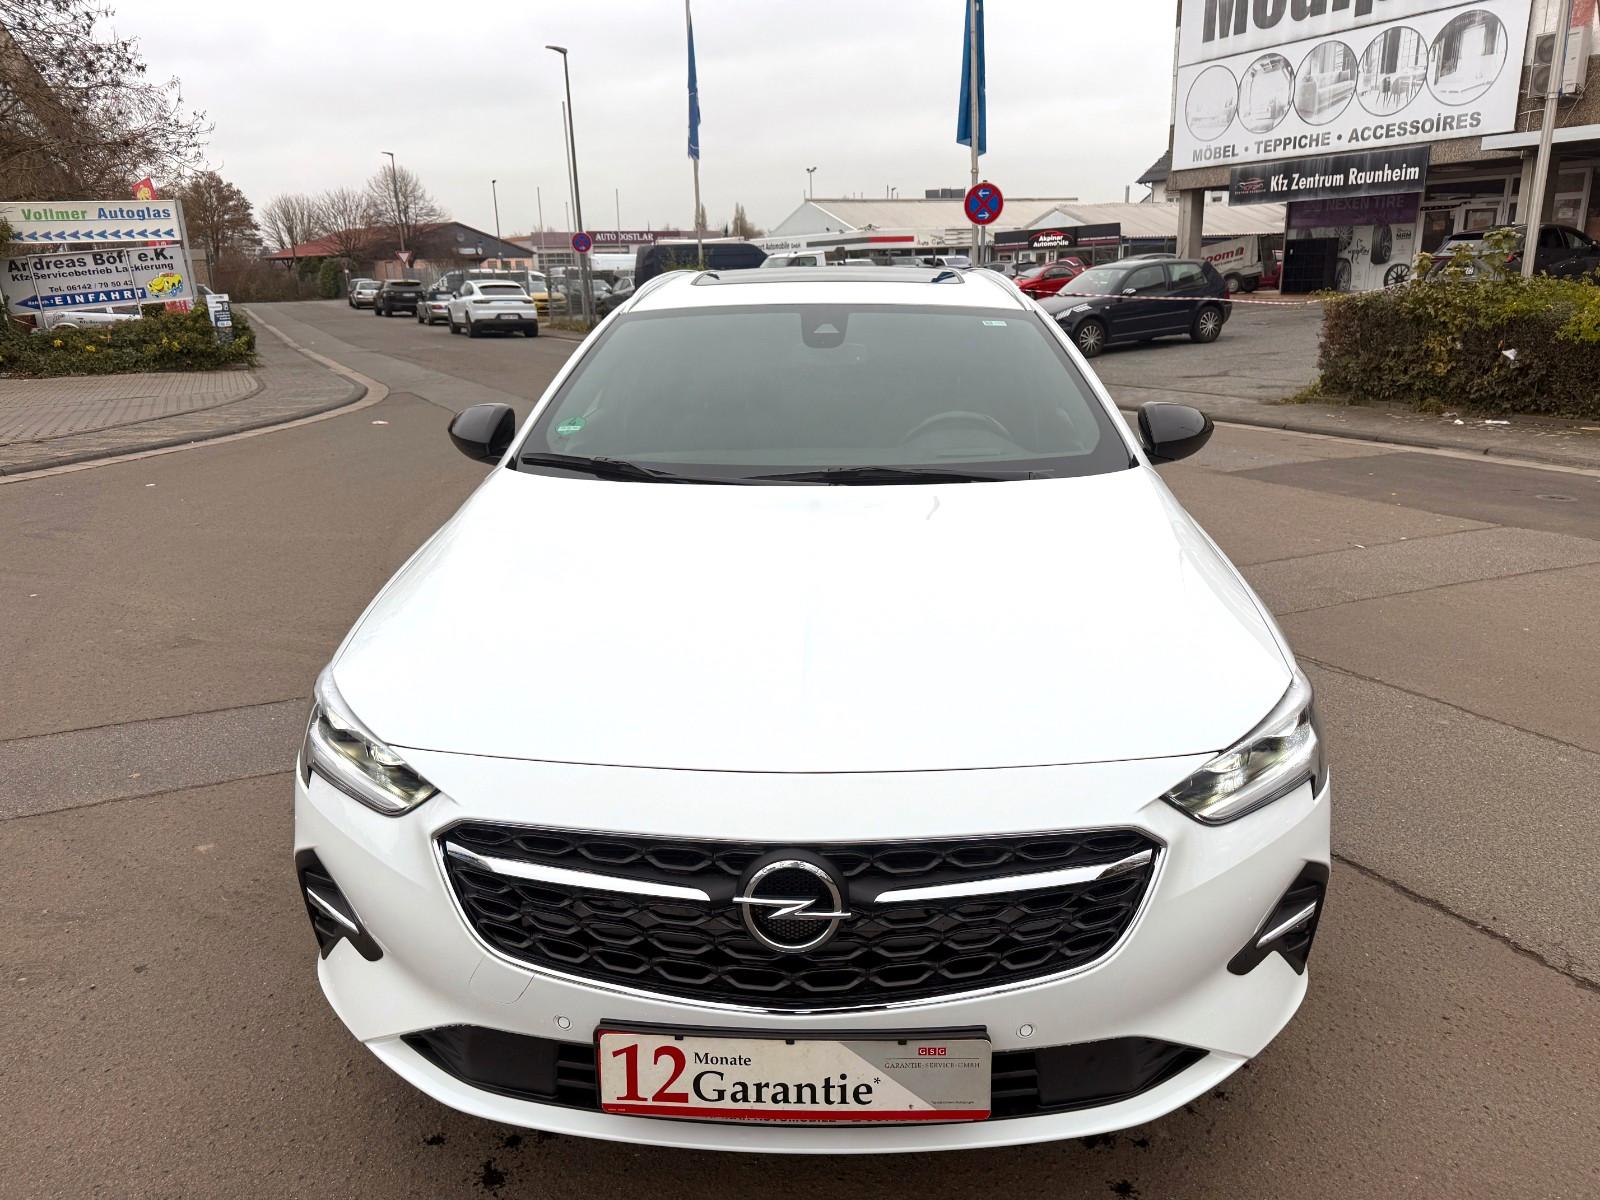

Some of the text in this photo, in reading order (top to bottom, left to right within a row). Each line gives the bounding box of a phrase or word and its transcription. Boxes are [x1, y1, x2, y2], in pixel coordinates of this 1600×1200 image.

[1192, 144, 1239, 162] MÖBEL
[1254, 131, 1331, 155] TEPPICHE
[1270, 163, 1420, 192] Kfz Zentrum Raunheim
[21, 206, 171, 221] Vollmer Autoglas
[594, 232, 616, 241] AUTO
[137, 247, 174, 262] e.K.
[115, 263, 174, 273] Lackierung
[66, 283, 92, 292] 06142
[54, 289, 143, 305] EINFAHRT
[693, 1051, 752, 1067] Monate
[612, 1043, 689, 1103] 12
